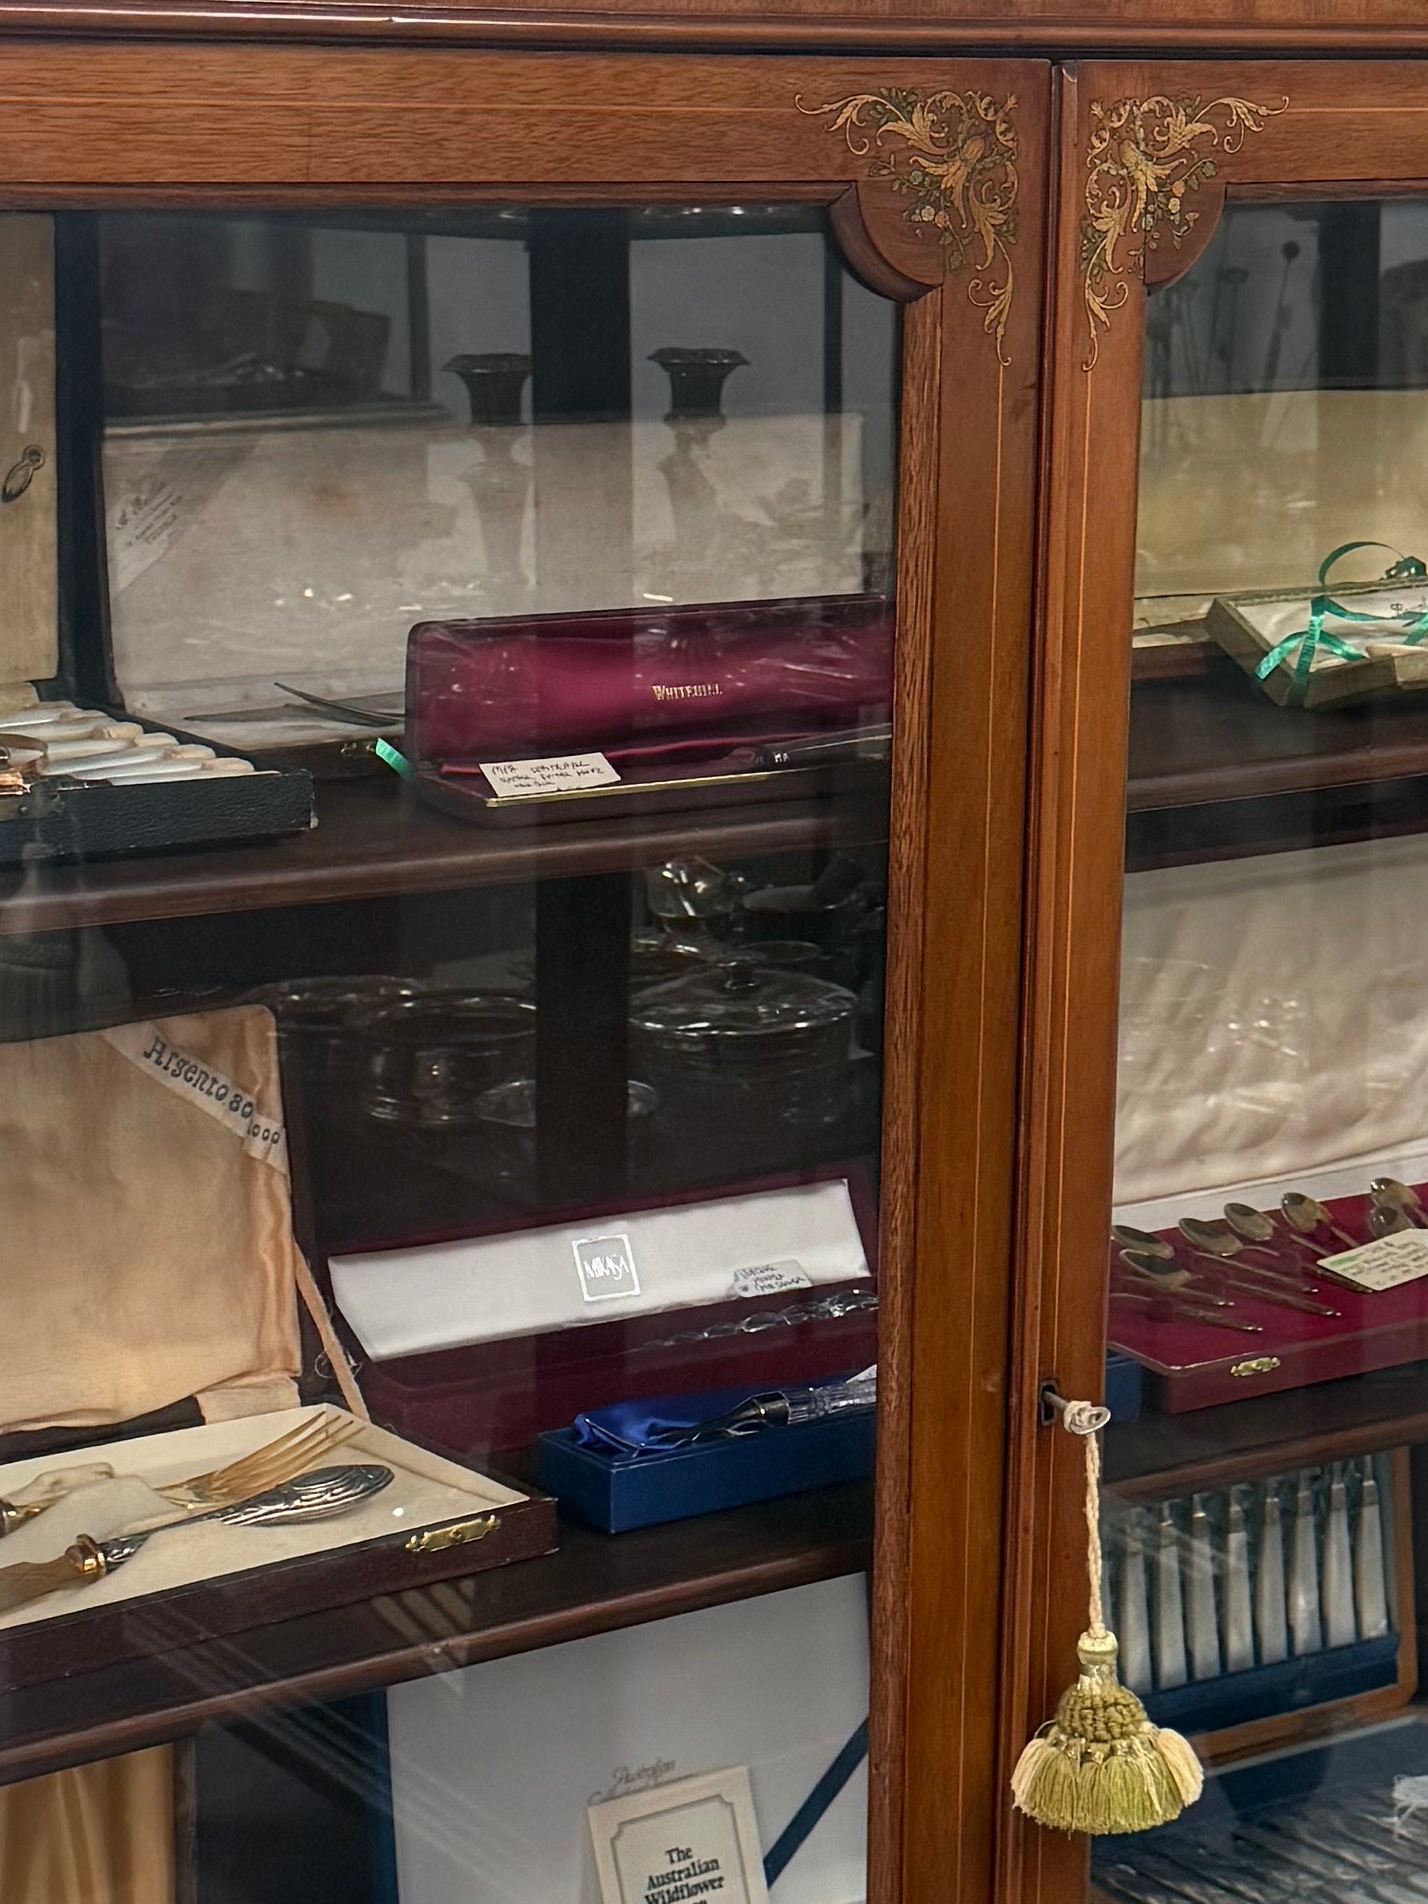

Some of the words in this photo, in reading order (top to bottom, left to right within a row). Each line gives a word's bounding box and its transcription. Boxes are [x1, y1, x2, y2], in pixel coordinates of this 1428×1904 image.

[143, 1035, 229, 1102] Argento
[665, 1846, 693, 1865] The
[646, 1857, 720, 1892] Australian
